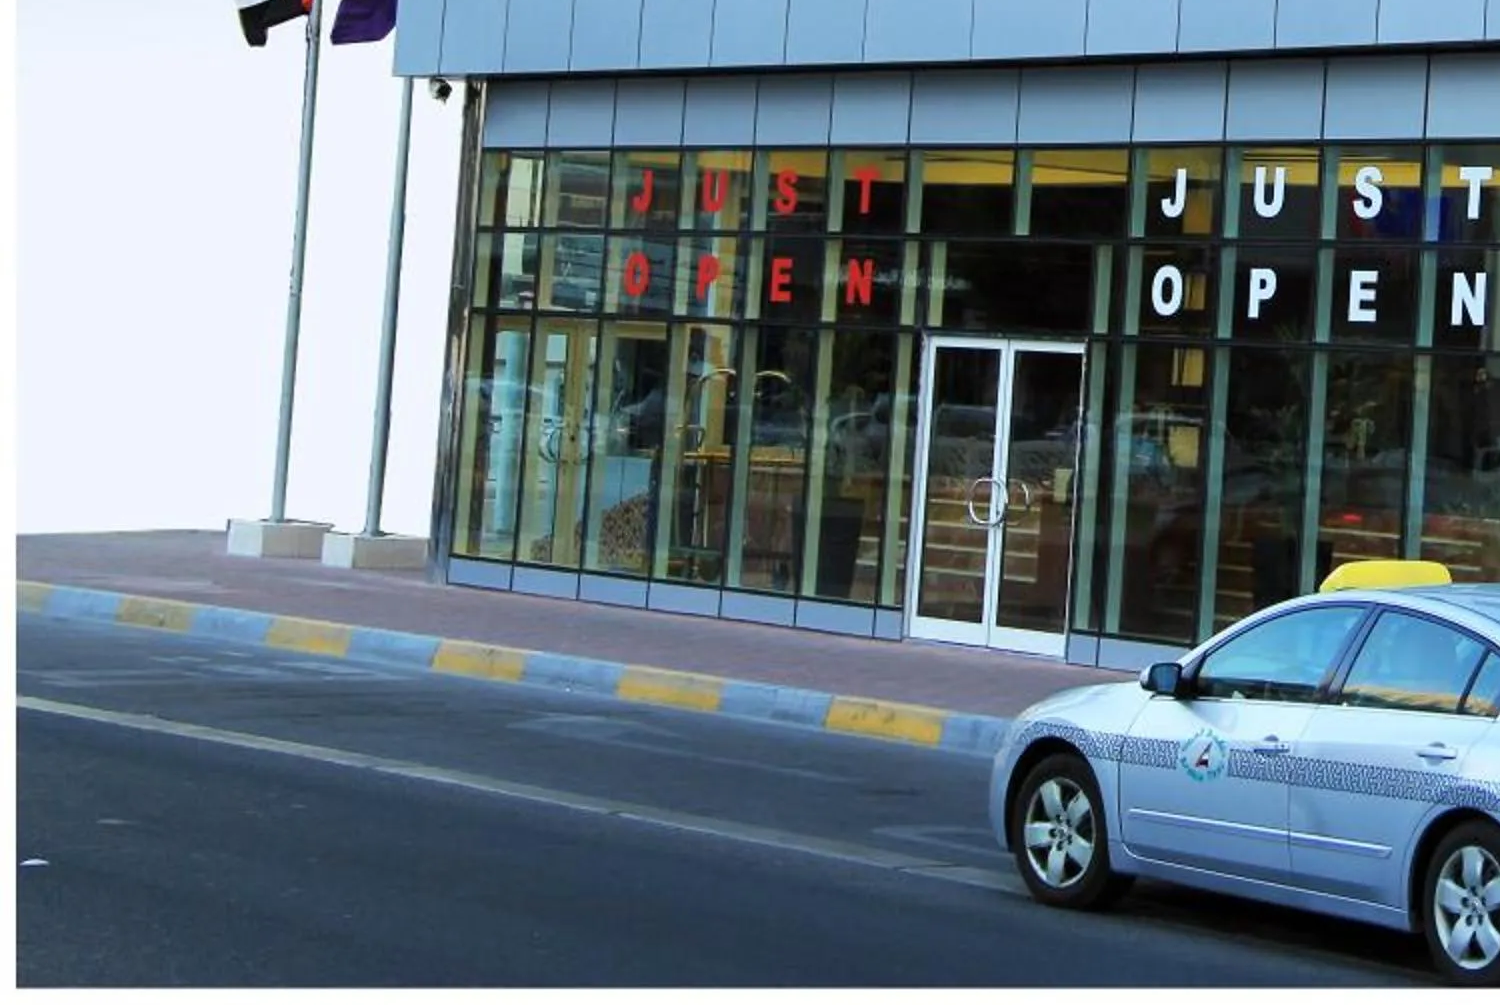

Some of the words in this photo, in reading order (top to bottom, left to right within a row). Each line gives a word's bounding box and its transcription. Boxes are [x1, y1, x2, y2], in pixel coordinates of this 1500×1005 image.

[632, 164, 880, 215] JUST
[1160, 165, 1493, 220] JUST
[623, 251, 874, 306] OPEN
[1151, 264, 1487, 326] OPEN
